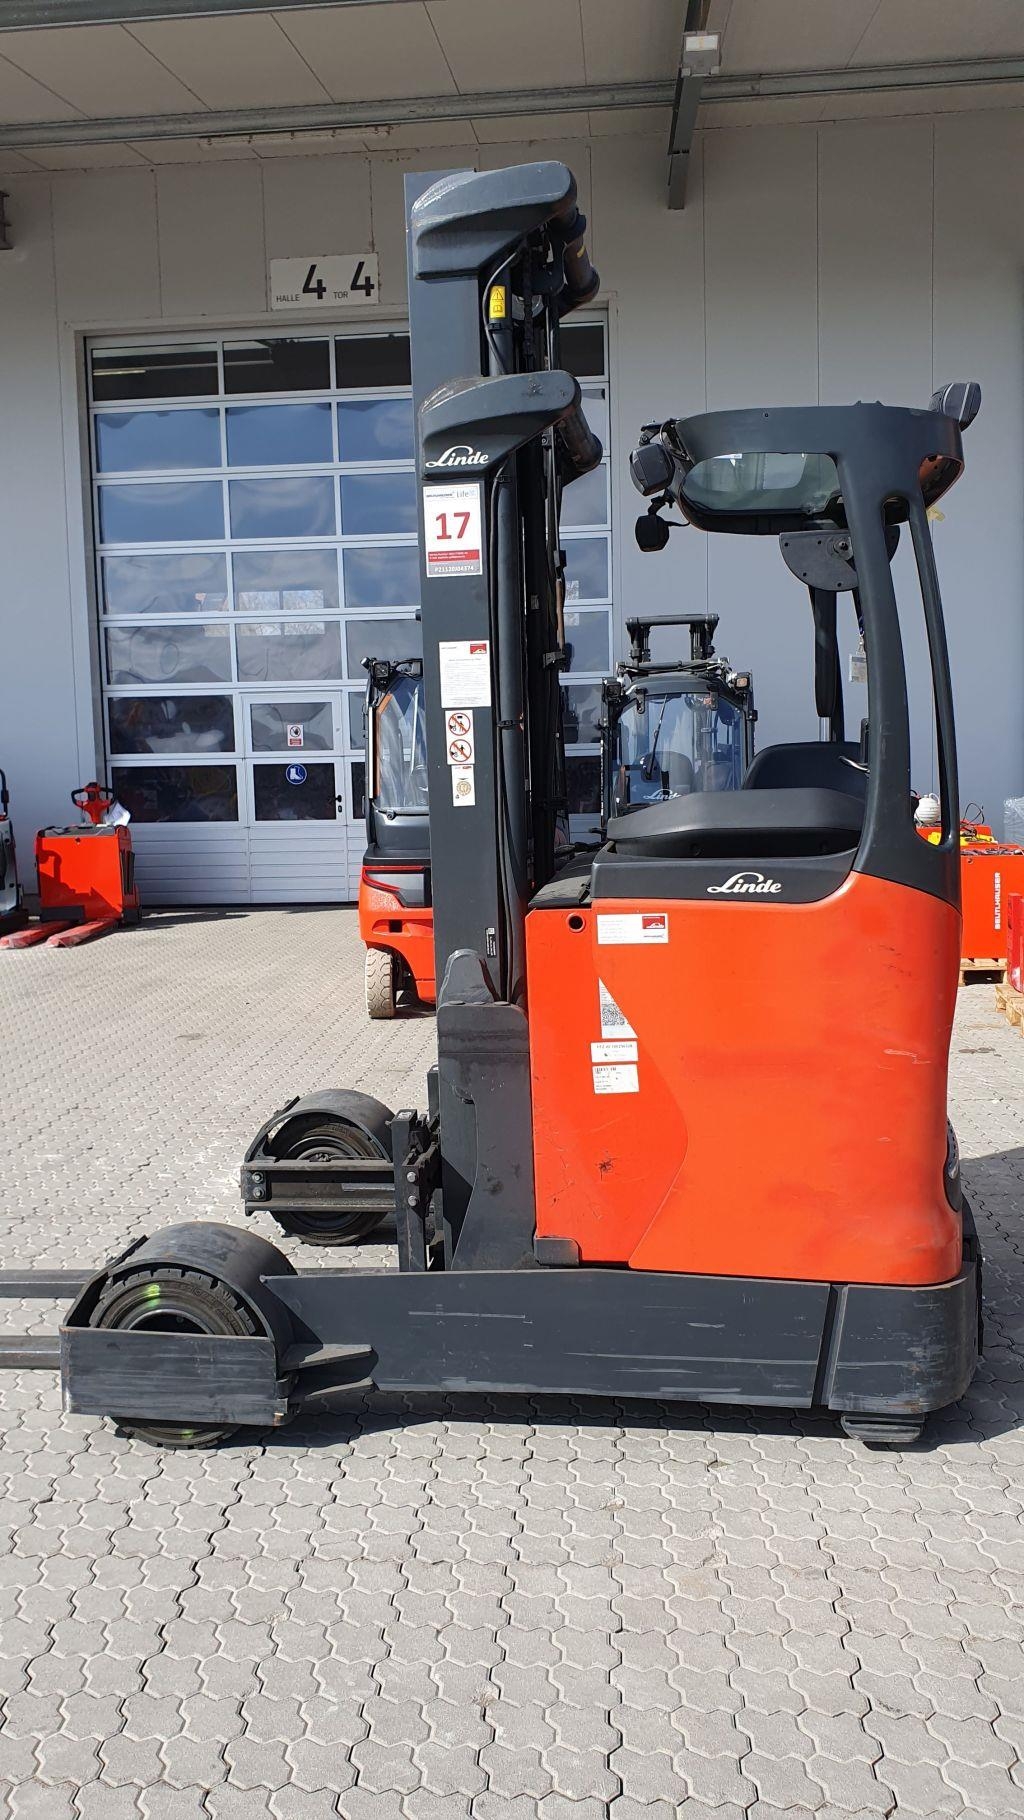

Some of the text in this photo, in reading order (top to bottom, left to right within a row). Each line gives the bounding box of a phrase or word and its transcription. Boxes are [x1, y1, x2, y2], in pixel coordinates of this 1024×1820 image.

[276, 261, 375, 302] HALLE 4 TOR 4
[425, 445, 489, 468] Linde
[435, 511, 471, 540] 17
[706, 871, 782, 894] Linde
